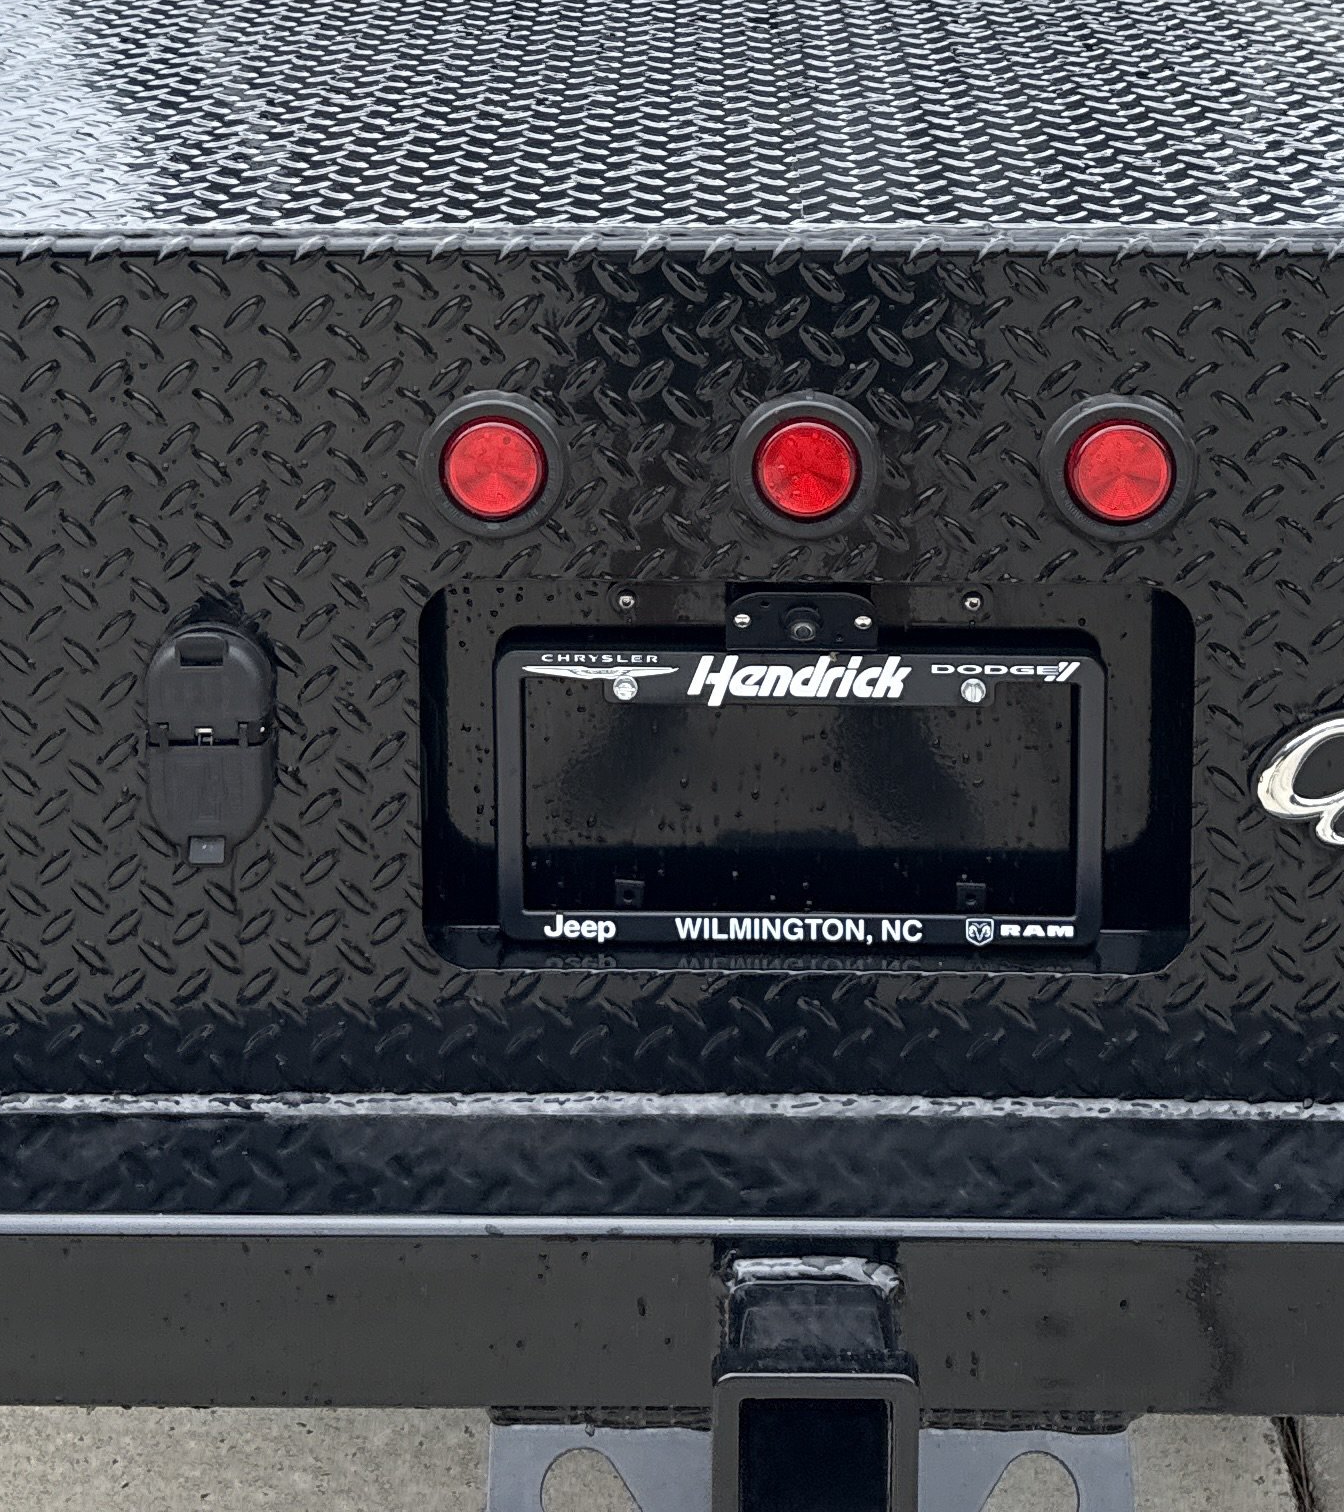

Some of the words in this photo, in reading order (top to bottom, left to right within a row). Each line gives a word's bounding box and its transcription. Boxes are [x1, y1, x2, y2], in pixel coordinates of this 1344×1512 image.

[540, 653, 659, 664] CHRYSLER
[930, 663, 1060, 676] DODGE
[686, 654, 913, 707] Hendrick
[543, 914, 616, 943] Jeep
[674, 917, 873, 945] WILMINGTON,
[881, 919, 923, 942] NC
[1000, 924, 1075, 938] RAM
